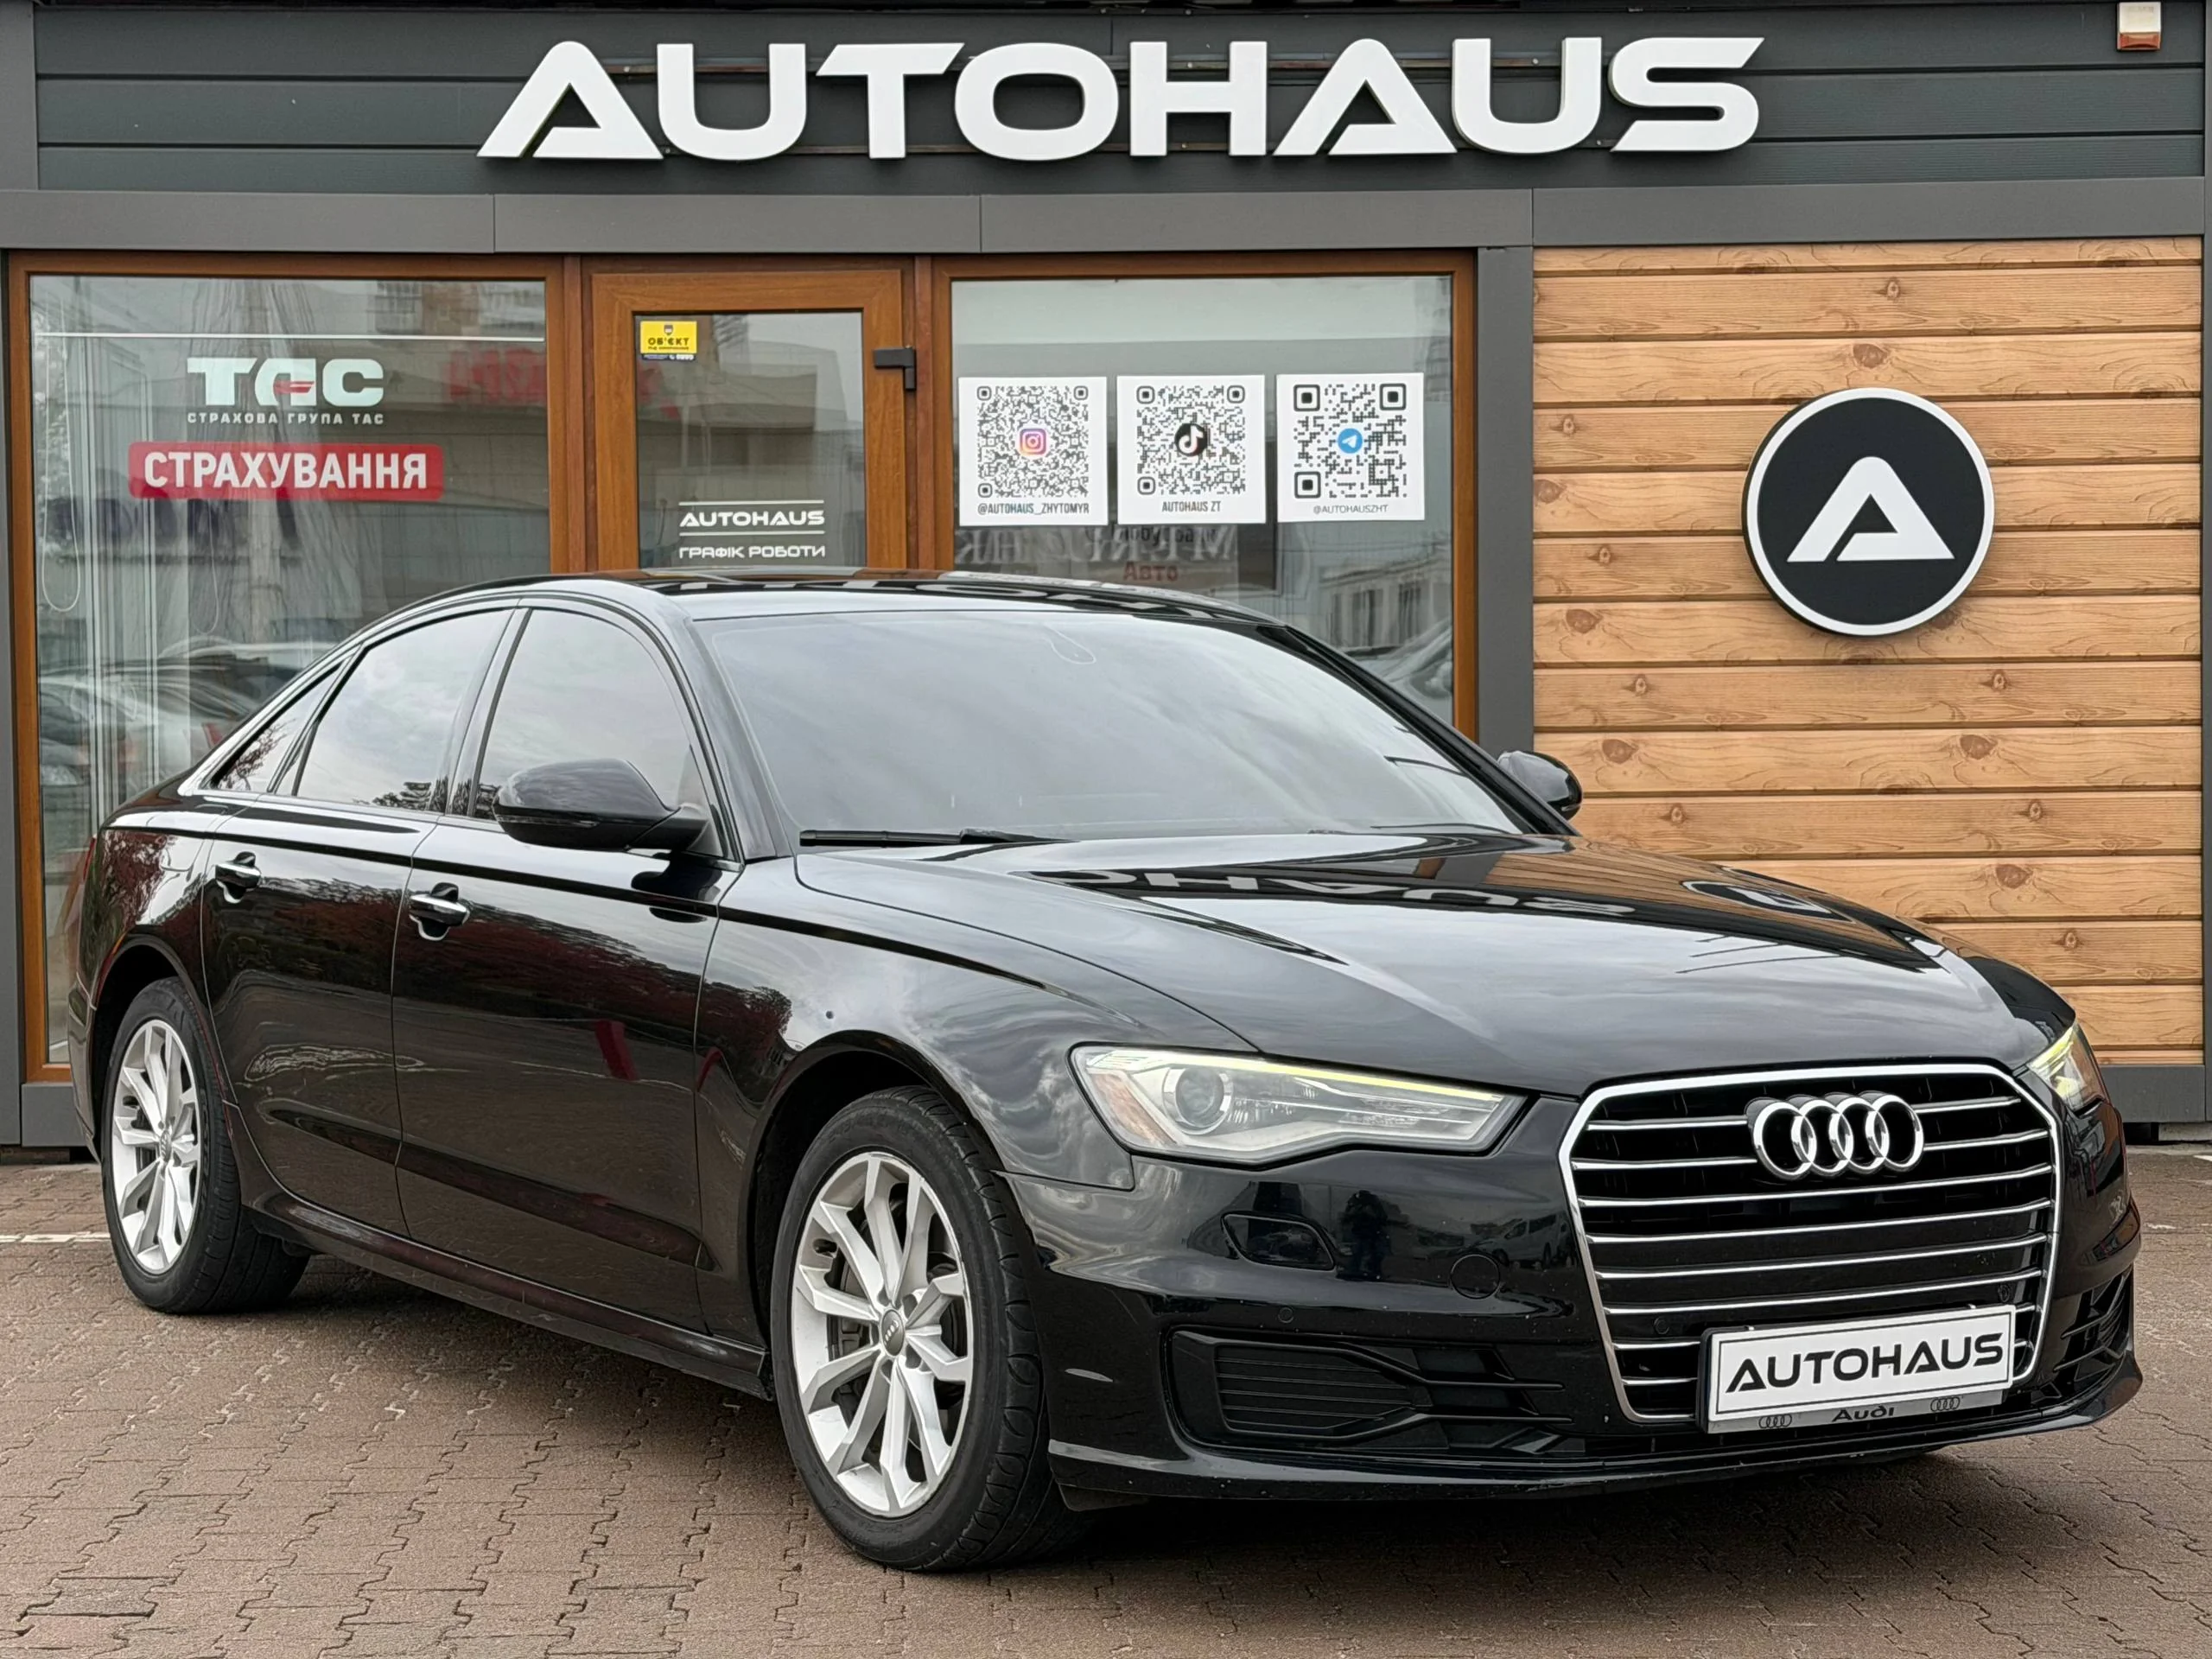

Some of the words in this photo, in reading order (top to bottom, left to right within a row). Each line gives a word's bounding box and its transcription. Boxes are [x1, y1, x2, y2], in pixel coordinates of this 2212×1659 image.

[476, 37, 1764, 161] AUTOHAUS
[188, 412, 278, 424] СТРАХОВА
[288, 413, 343, 424] ГРУПА
[352, 413, 384, 424] ТАС
[144, 452, 427, 489] СТРАХУВАННЯ
[1162, 500, 1208, 512] AUTOHAUS
[1211, 500, 1222, 512] ZT
[679, 510, 826, 527] AUTOHAUS
[679, 546, 745, 559] ГРАФІК
[748, 545, 826, 558] РОБОТИ
[1726, 1332, 2003, 1393] AUTOHAUS
[1832, 1406, 1894, 1422] Audi
